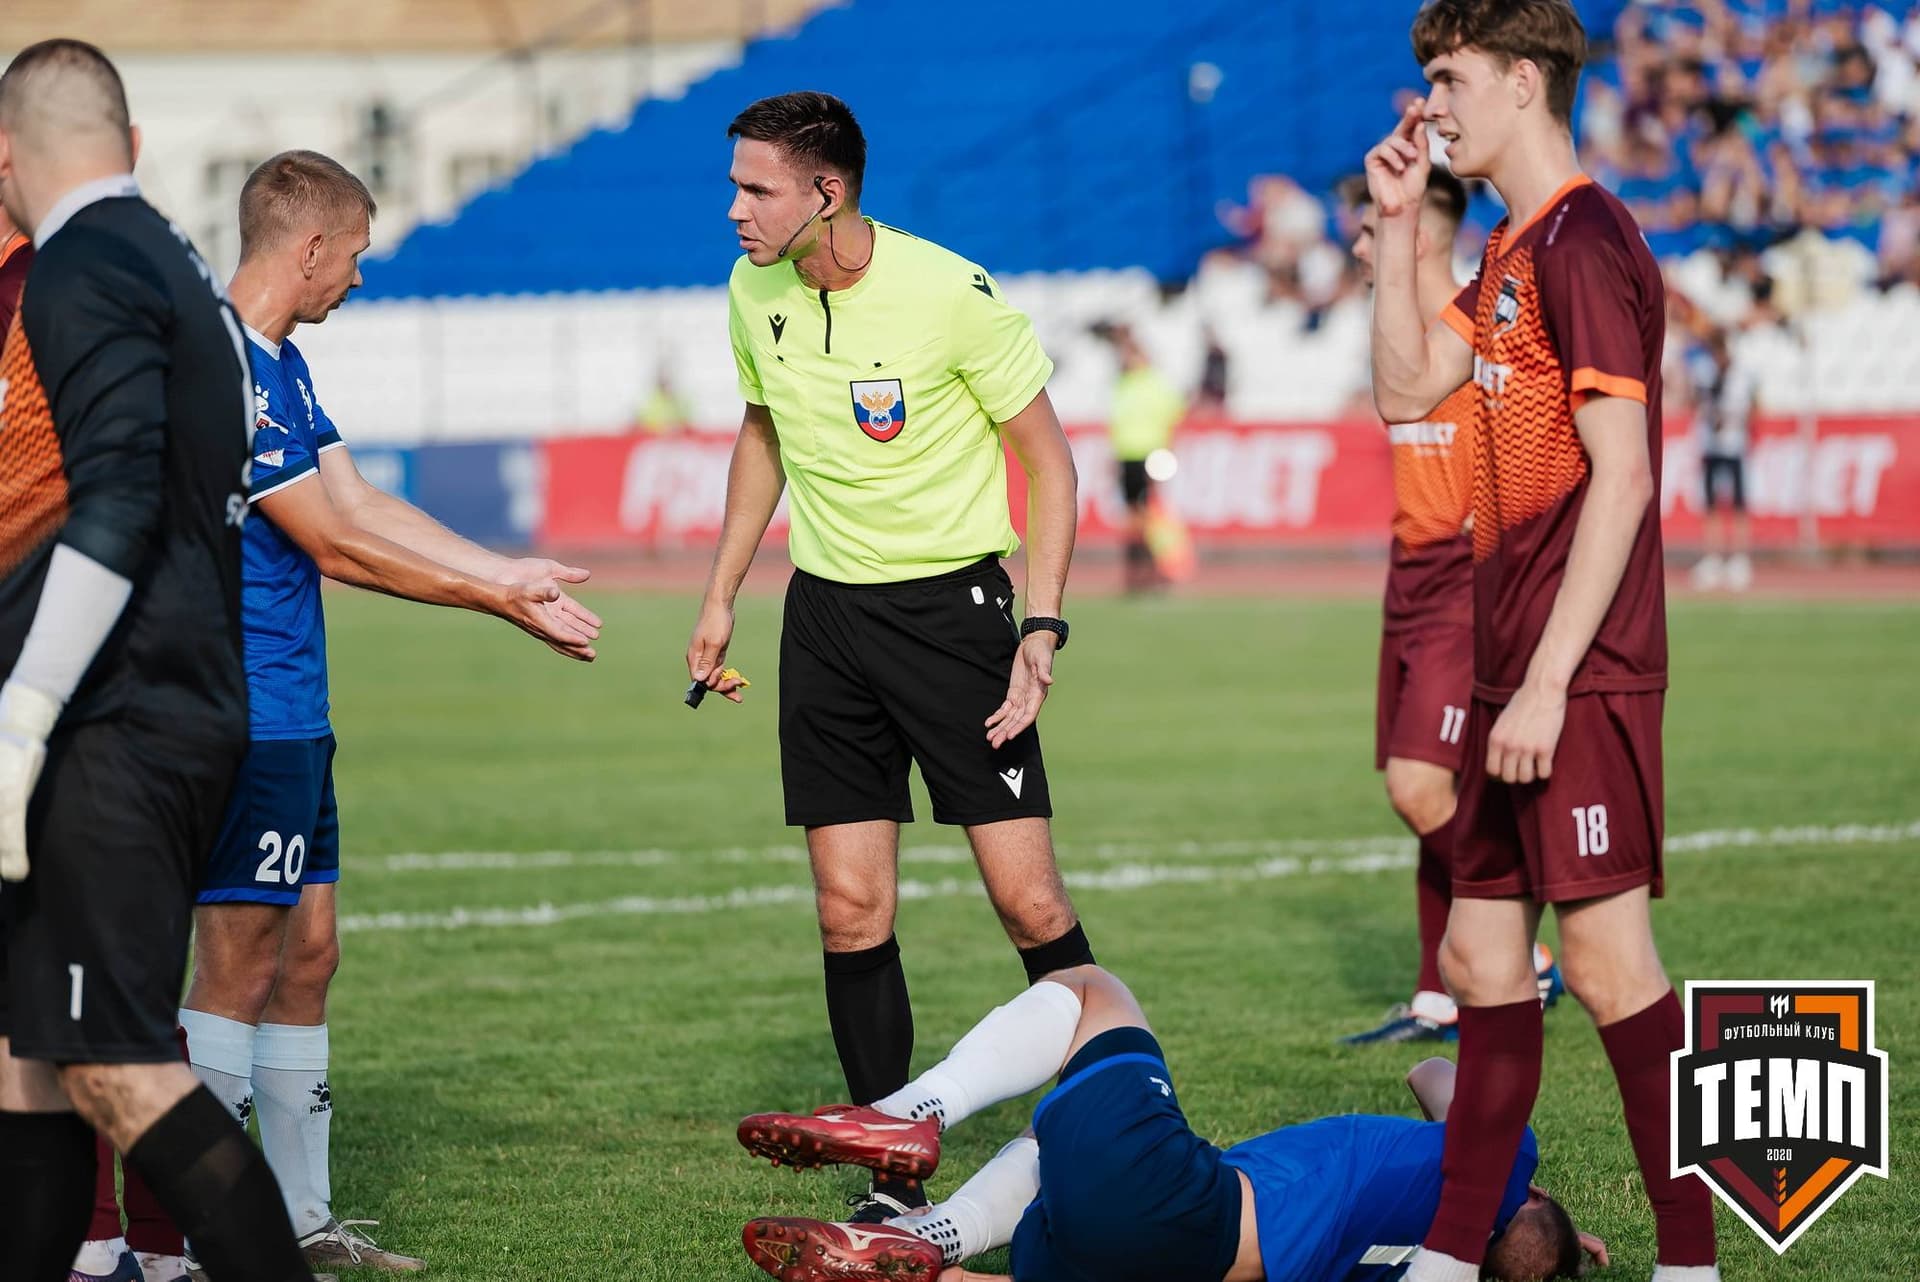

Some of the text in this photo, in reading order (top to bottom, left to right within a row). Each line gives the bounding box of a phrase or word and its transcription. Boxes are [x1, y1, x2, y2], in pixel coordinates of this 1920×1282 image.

[1439, 705, 1466, 744] 11
[1571, 803, 1610, 857] 18
[255, 830, 305, 885] 20
[68, 963, 84, 1020] 1
